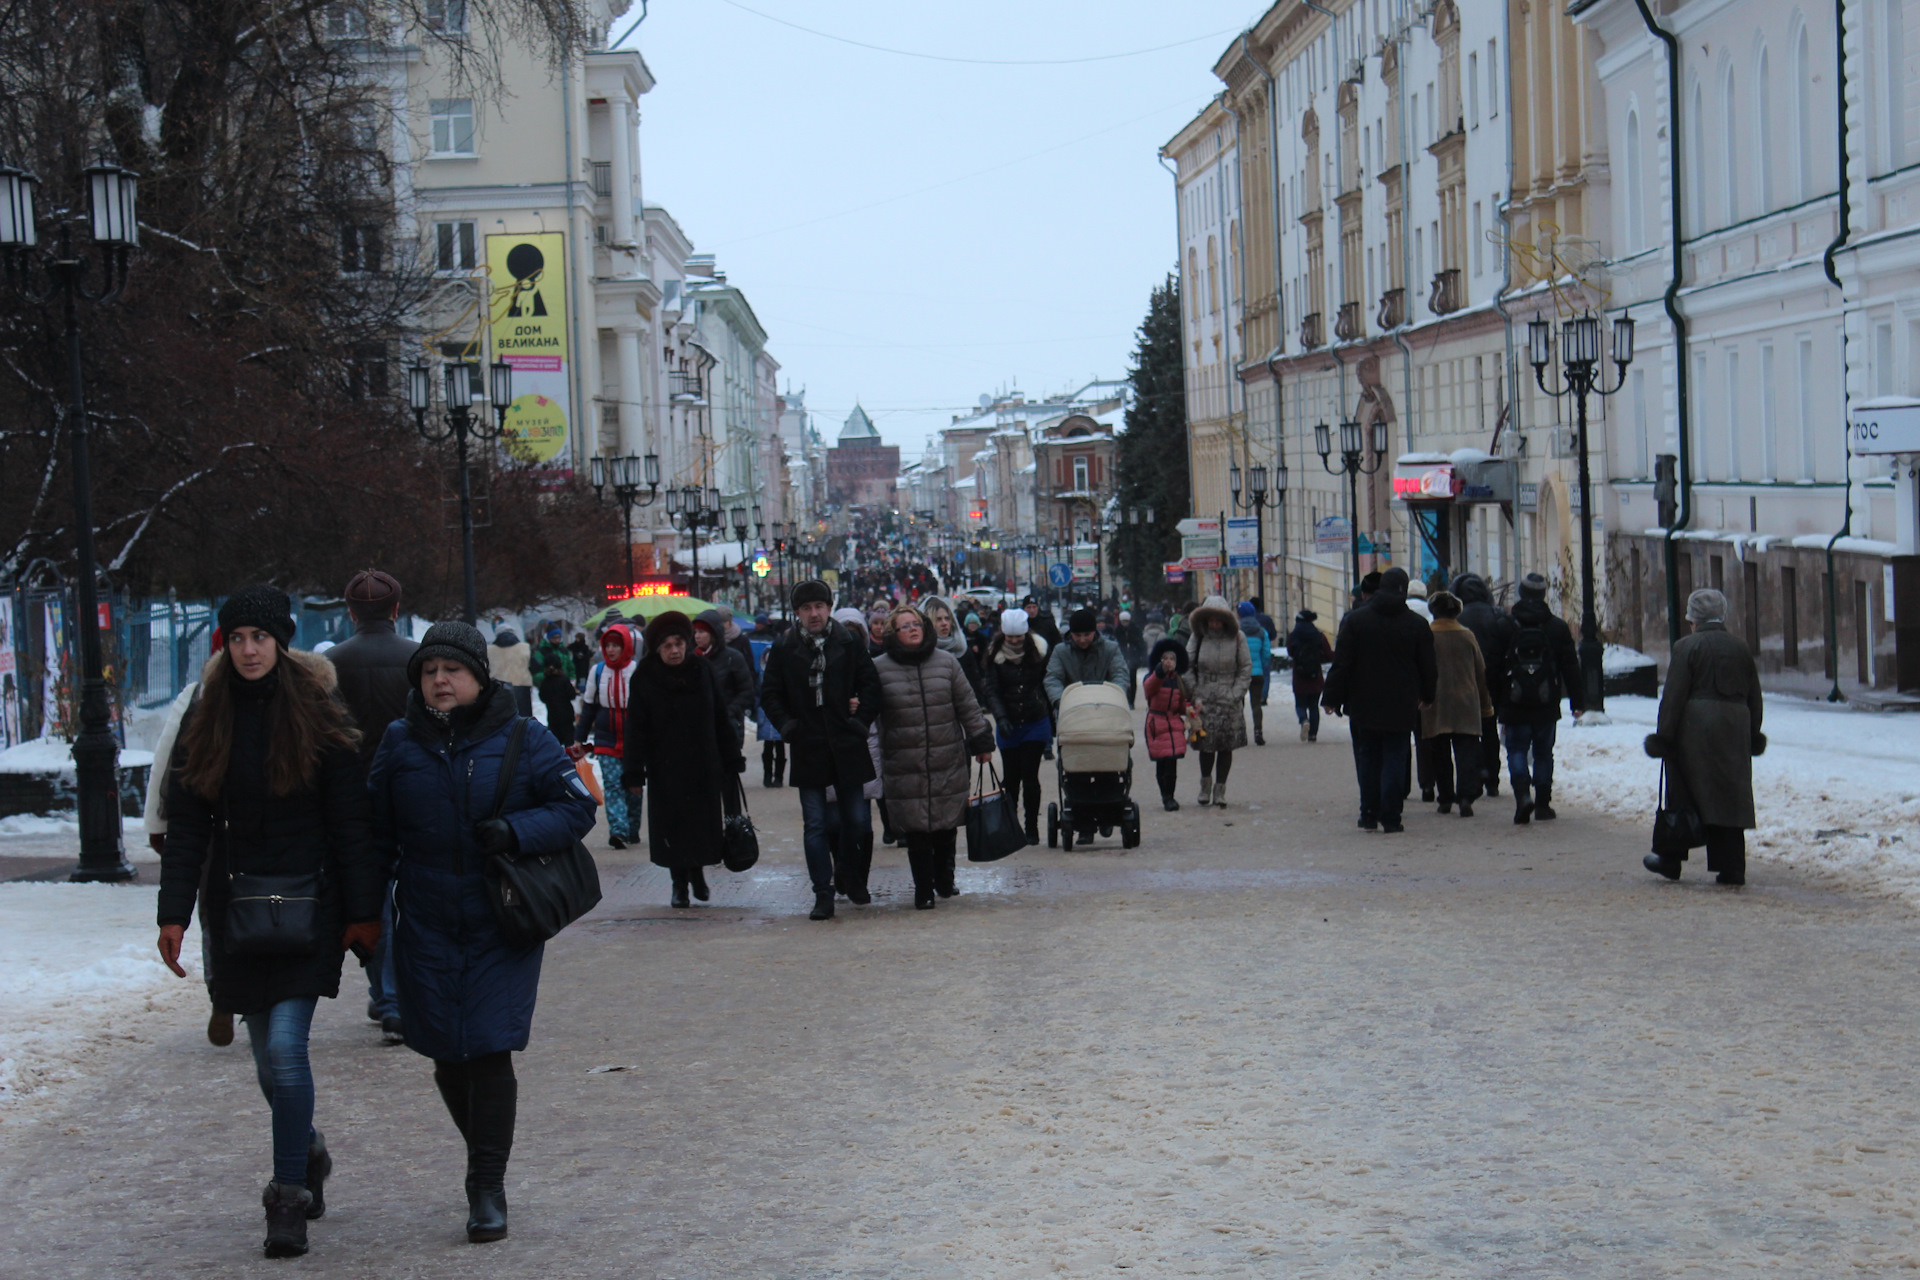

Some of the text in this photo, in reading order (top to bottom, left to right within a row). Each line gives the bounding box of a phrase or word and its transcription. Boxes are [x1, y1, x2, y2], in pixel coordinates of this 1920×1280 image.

[515, 325, 541, 336] ДОМ
[498, 337, 559, 348] ВЕЛИКАНА
[516, 417, 550, 426] МУЗЕЙ
